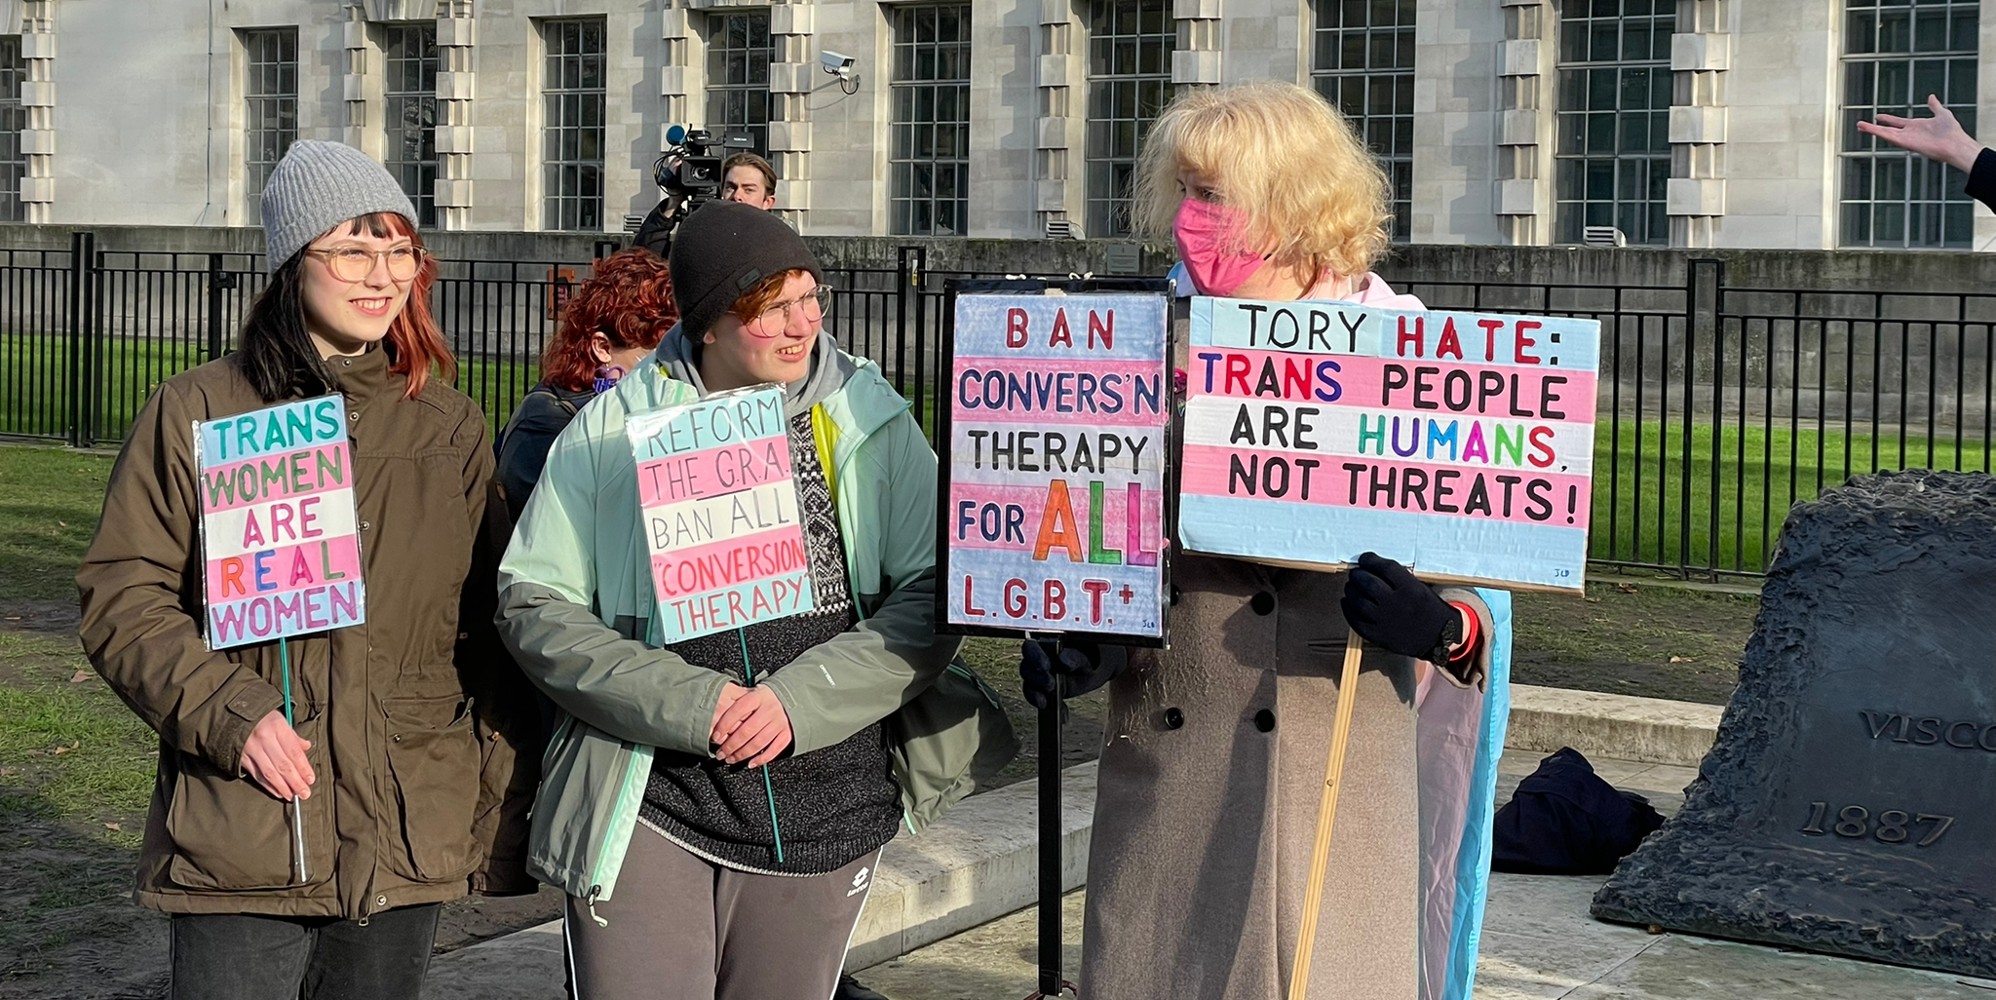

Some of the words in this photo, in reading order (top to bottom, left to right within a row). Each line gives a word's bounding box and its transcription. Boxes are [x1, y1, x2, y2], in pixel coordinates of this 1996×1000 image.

[1006, 307, 1114, 350] BAN
[1239, 304, 1367, 352] TORY
[1397, 315, 1561, 366] HATE:
[958, 369, 1159, 415] CONVERS'N
[1197, 353, 1342, 402] TRANS
[1382, 364, 1568, 419] PEOPLE
[213, 401, 339, 459] TRANS
[968, 430, 1148, 475] THERAPY
[1229, 404, 1320, 450] ARE
[1358, 412, 1568, 473] HUMANS,
[204, 446, 343, 507] WOMEN
[645, 457, 703, 500] THE
[1229, 453, 1320, 500] NOT
[1342, 463, 1577, 524] THREATS!
[243, 496, 323, 549] ARE
[651, 506, 713, 549] BAN
[731, 487, 790, 534] ALL
[958, 500, 1025, 544] FOR
[1032, 479, 1158, 567] ALL
[221, 540, 346, 598] REAL
[211, 581, 358, 643] WOMEN
[1802, 801, 1956, 847] 1887
